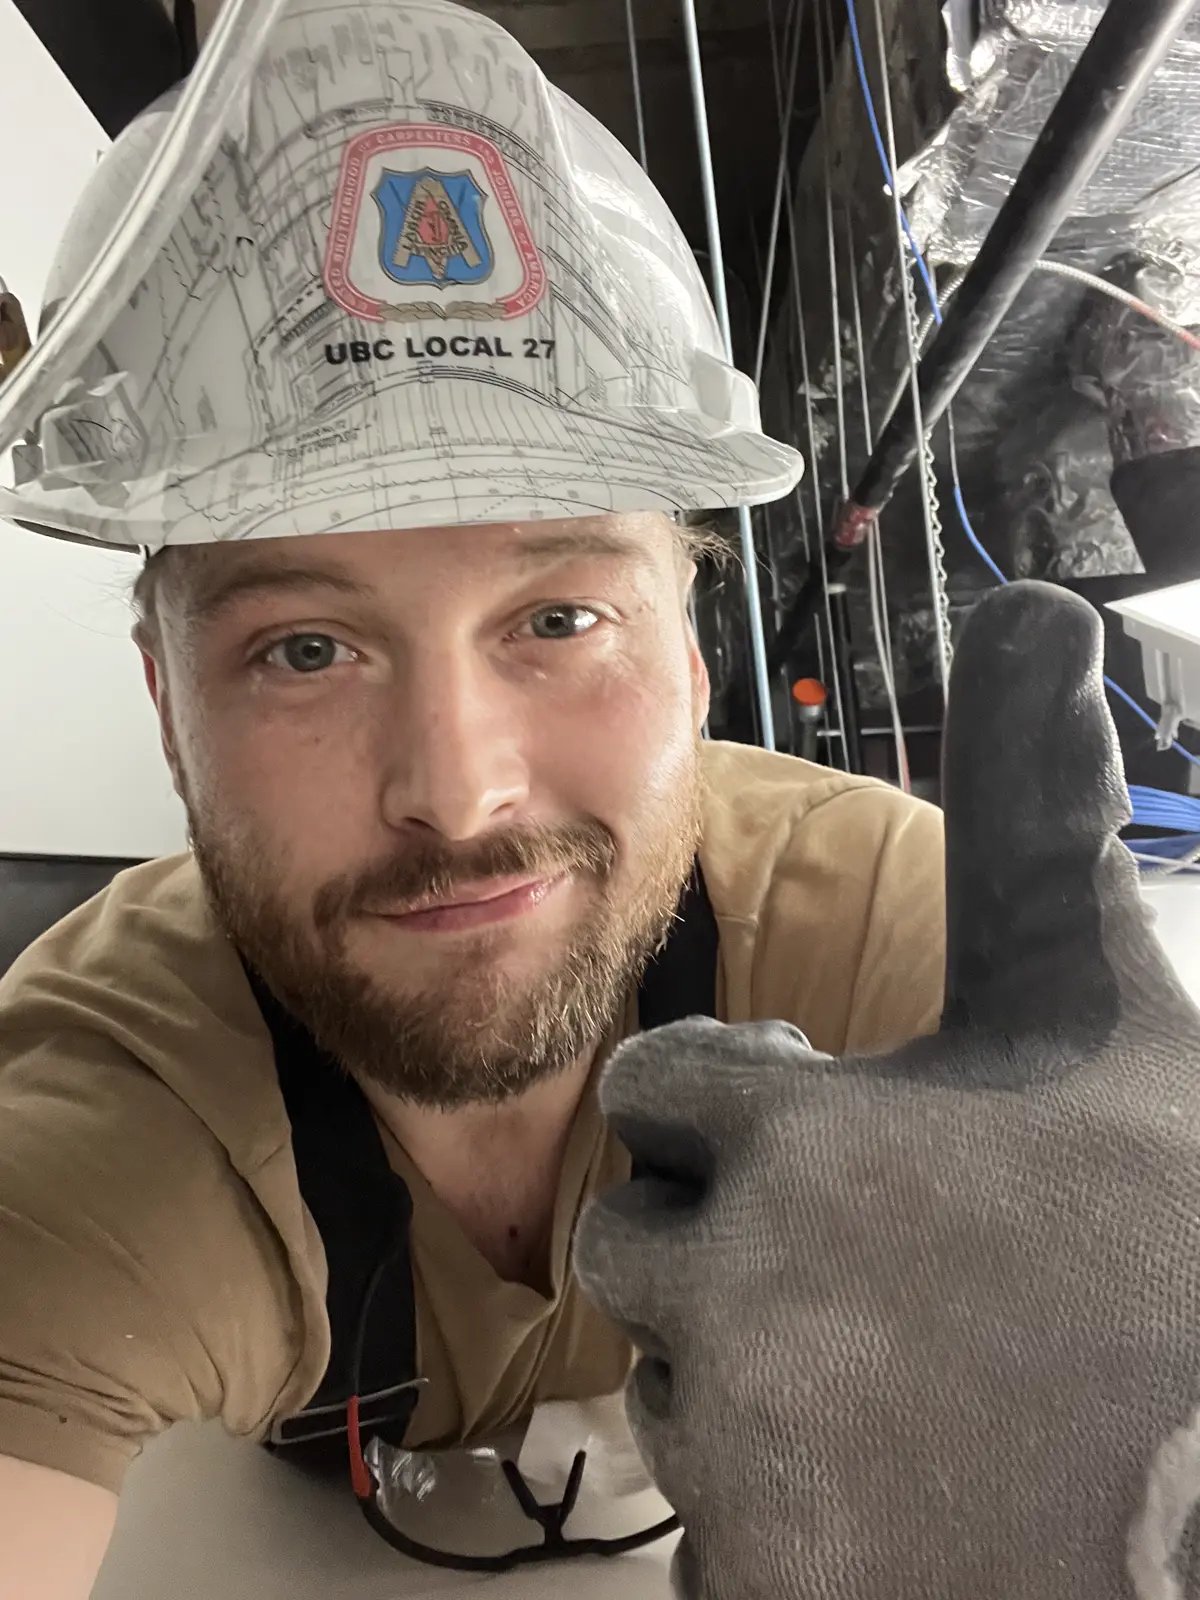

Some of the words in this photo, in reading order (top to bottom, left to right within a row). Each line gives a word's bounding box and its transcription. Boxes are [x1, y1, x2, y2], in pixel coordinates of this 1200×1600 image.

[376, 131, 472, 146] CARPENTERS
[493, 170, 522, 227] JOINERS
[515, 251, 541, 308] AMERICA
[325, 339, 395, 364] UBC
[406, 336, 513, 358] LOCAL
[522, 338, 556, 359] 27
